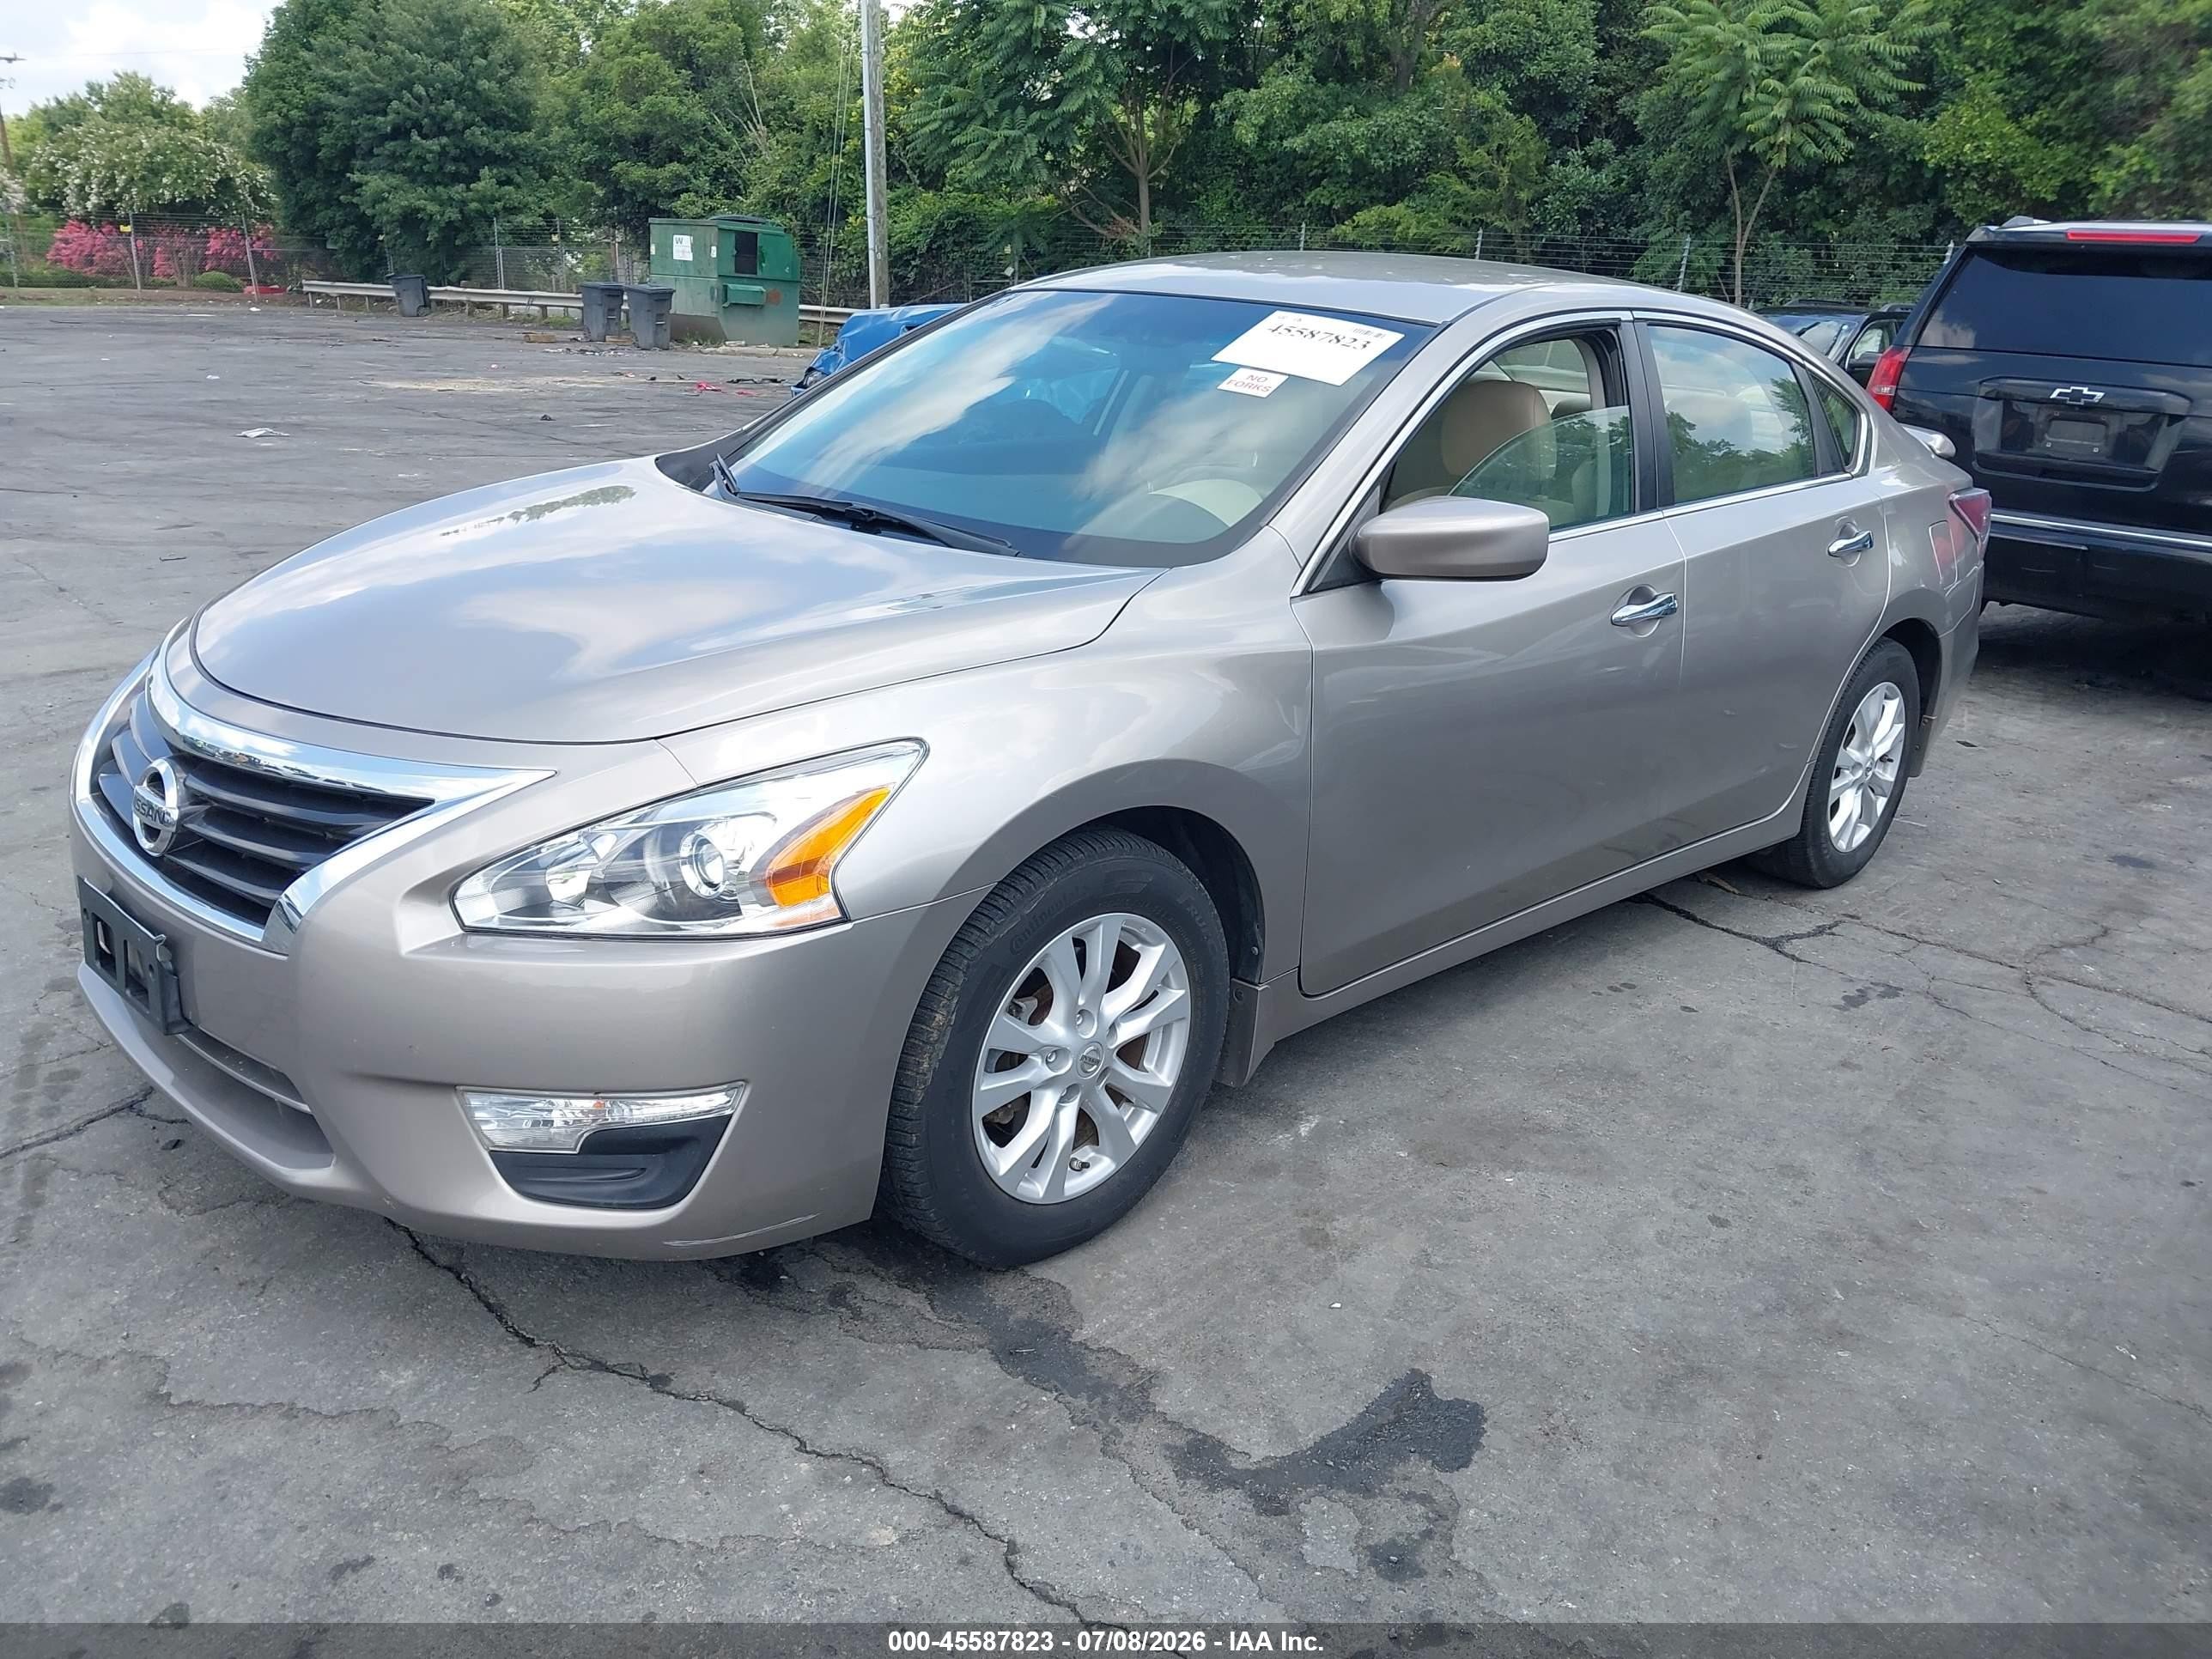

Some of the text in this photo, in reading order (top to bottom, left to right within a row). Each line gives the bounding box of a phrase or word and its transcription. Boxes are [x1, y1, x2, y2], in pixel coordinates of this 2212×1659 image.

[1267, 324, 1371, 349] 45587823
[1246, 374, 1268, 383] NO
[1226, 380, 1272, 392] FORKS
